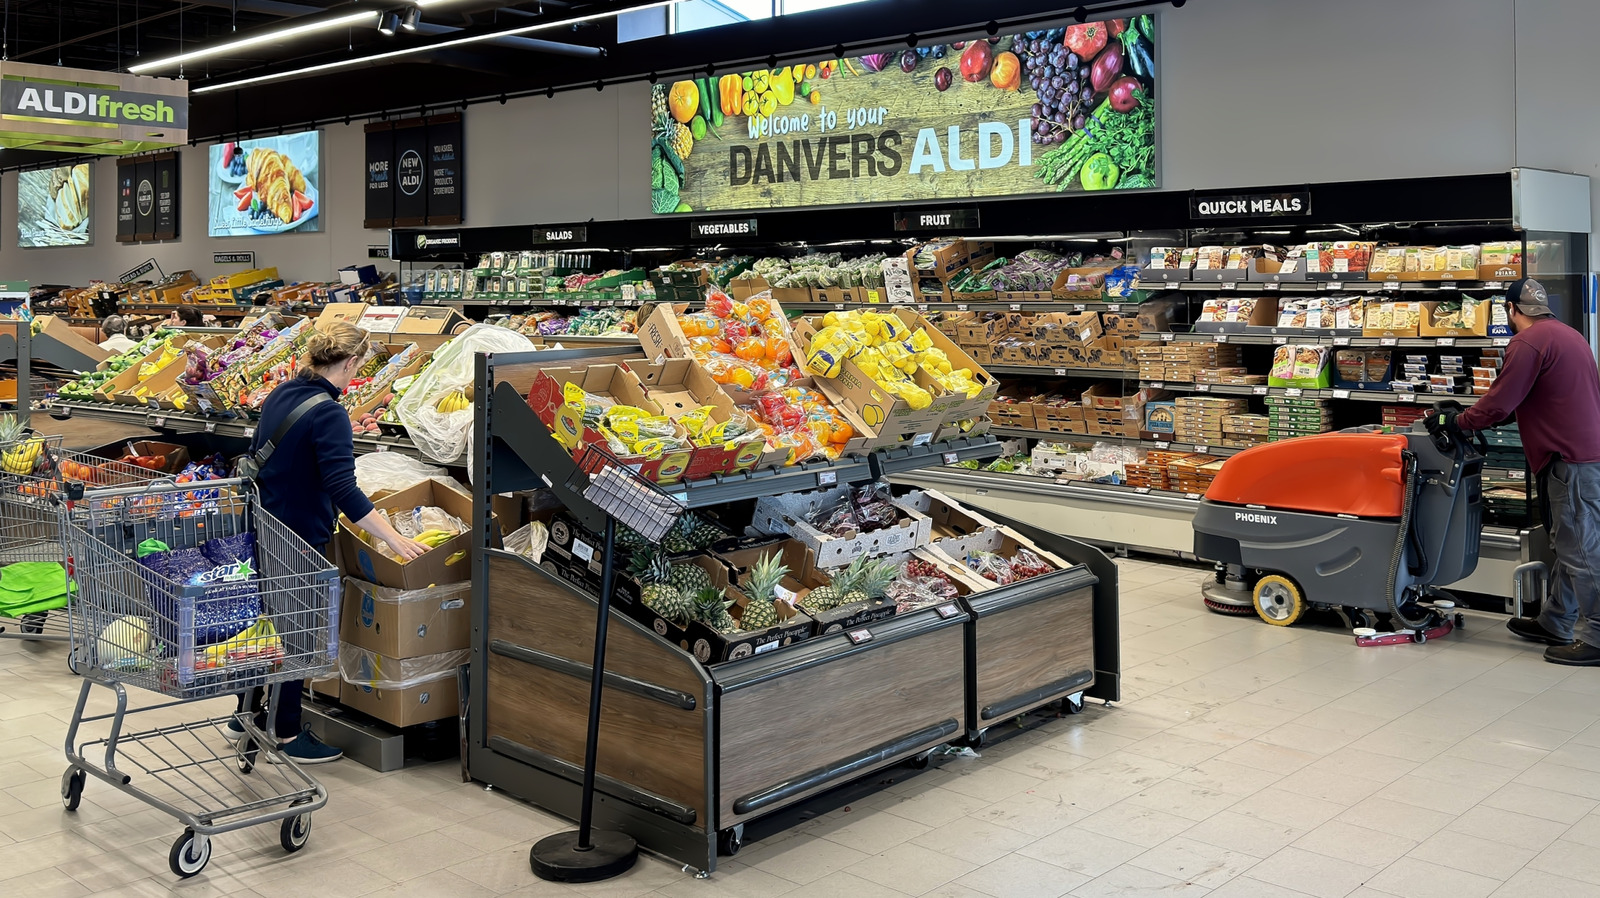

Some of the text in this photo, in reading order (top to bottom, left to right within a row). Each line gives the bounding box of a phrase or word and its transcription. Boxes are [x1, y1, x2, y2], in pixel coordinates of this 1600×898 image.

[18, 88, 174, 123] ALDIfresh
[747, 105, 887, 139] Welcome to your
[729, 118, 1033, 187] DANVERS ALDI
[369, 161, 389, 173] MORE
[402, 158, 419, 169] NEW
[369, 180, 389, 190] FOR LESS
[402, 176, 420, 187] ALDI
[435, 177, 454, 186] PRODUCTS
[1198, 197, 1302, 215] QUICK MEALS
[920, 214, 951, 227] FRUIT
[698, 222, 750, 236] VEGETABLES
[442, 237, 458, 245] PRODUCE
[546, 231, 573, 241] SALADS
[122, 272, 137, 284] BREAD
[648, 323, 663, 348] FRESH
[838, 374, 854, 390] ONS
[841, 367, 862, 390] ORNIA
[1235, 513, 1277, 525] PHOENIX
[200, 563, 239, 583] star
[562, 570, 570, 580] The
[570, 574, 585, 589] Perfect
[846, 618, 856, 626] The
[756, 626, 809, 646] The Perfect Pineapple
